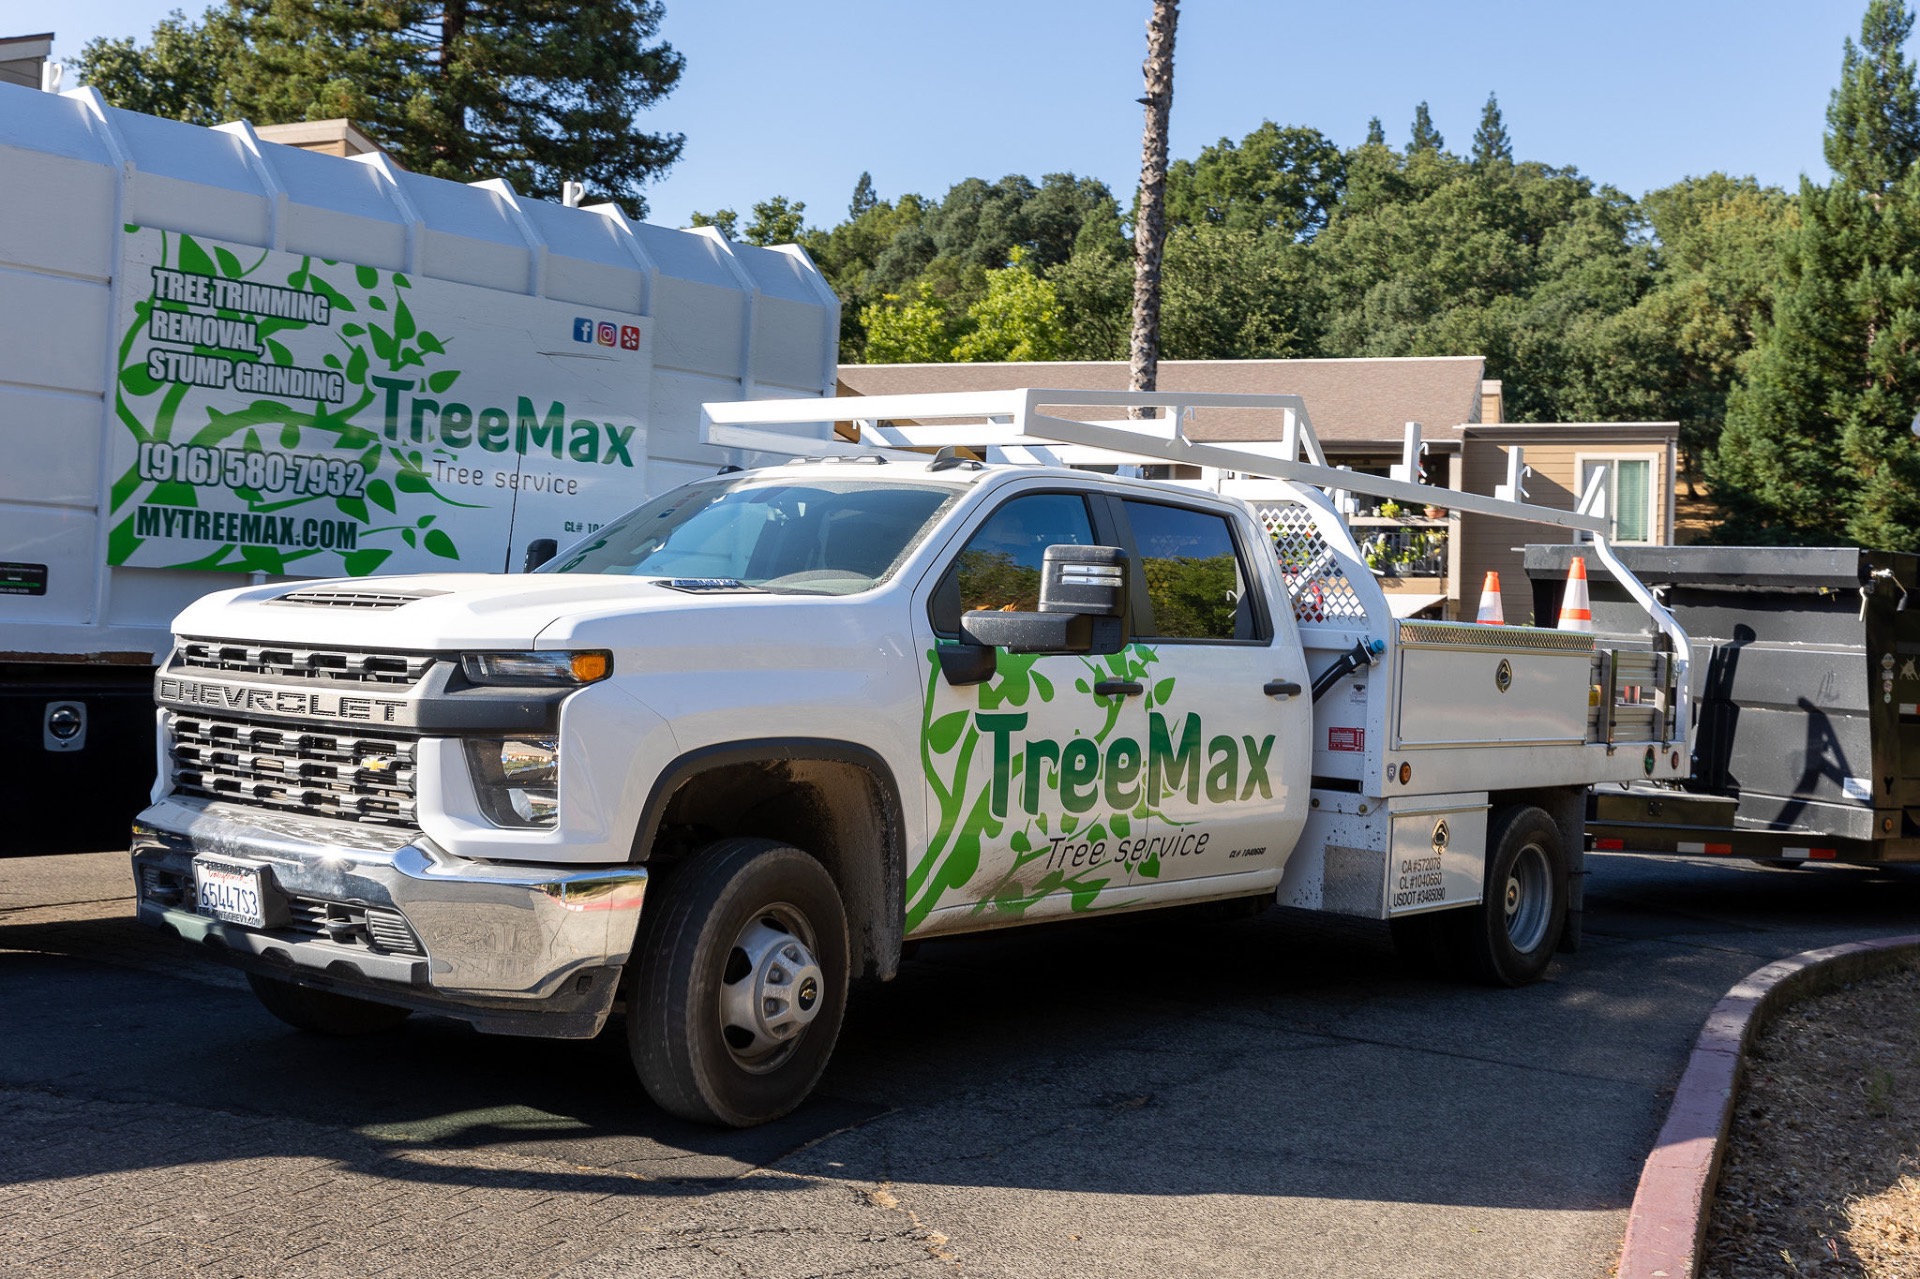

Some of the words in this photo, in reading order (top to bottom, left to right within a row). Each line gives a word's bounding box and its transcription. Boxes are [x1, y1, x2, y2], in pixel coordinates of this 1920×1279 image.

[152, 267, 211, 307] TREE
[212, 277, 330, 325] TRIMMING
[149, 307, 265, 357] REMOVAL,
[148, 348, 233, 389] STUMP
[233, 359, 344, 403] GRINDING
[371, 374, 637, 468] TreeMax
[138, 441, 222, 487] (916)
[223, 447, 366, 500] 580-7932
[433, 459, 484, 486] Tree
[495, 470, 578, 496] service
[136, 505, 358, 550] MYTREEMAX.COM
[564, 521, 583, 533] CL#
[160, 679, 408, 722] CHEVROLET
[974, 711, 1276, 818] TreeMax
[1046, 836, 1105, 870] Tree
[1114, 827, 1210, 863] service
[1402, 860, 1412, 874] CA
[201, 882, 258, 916] 65447S3
[1393, 891, 1416, 907] USDOT
[1400, 876, 1409, 890] CL
